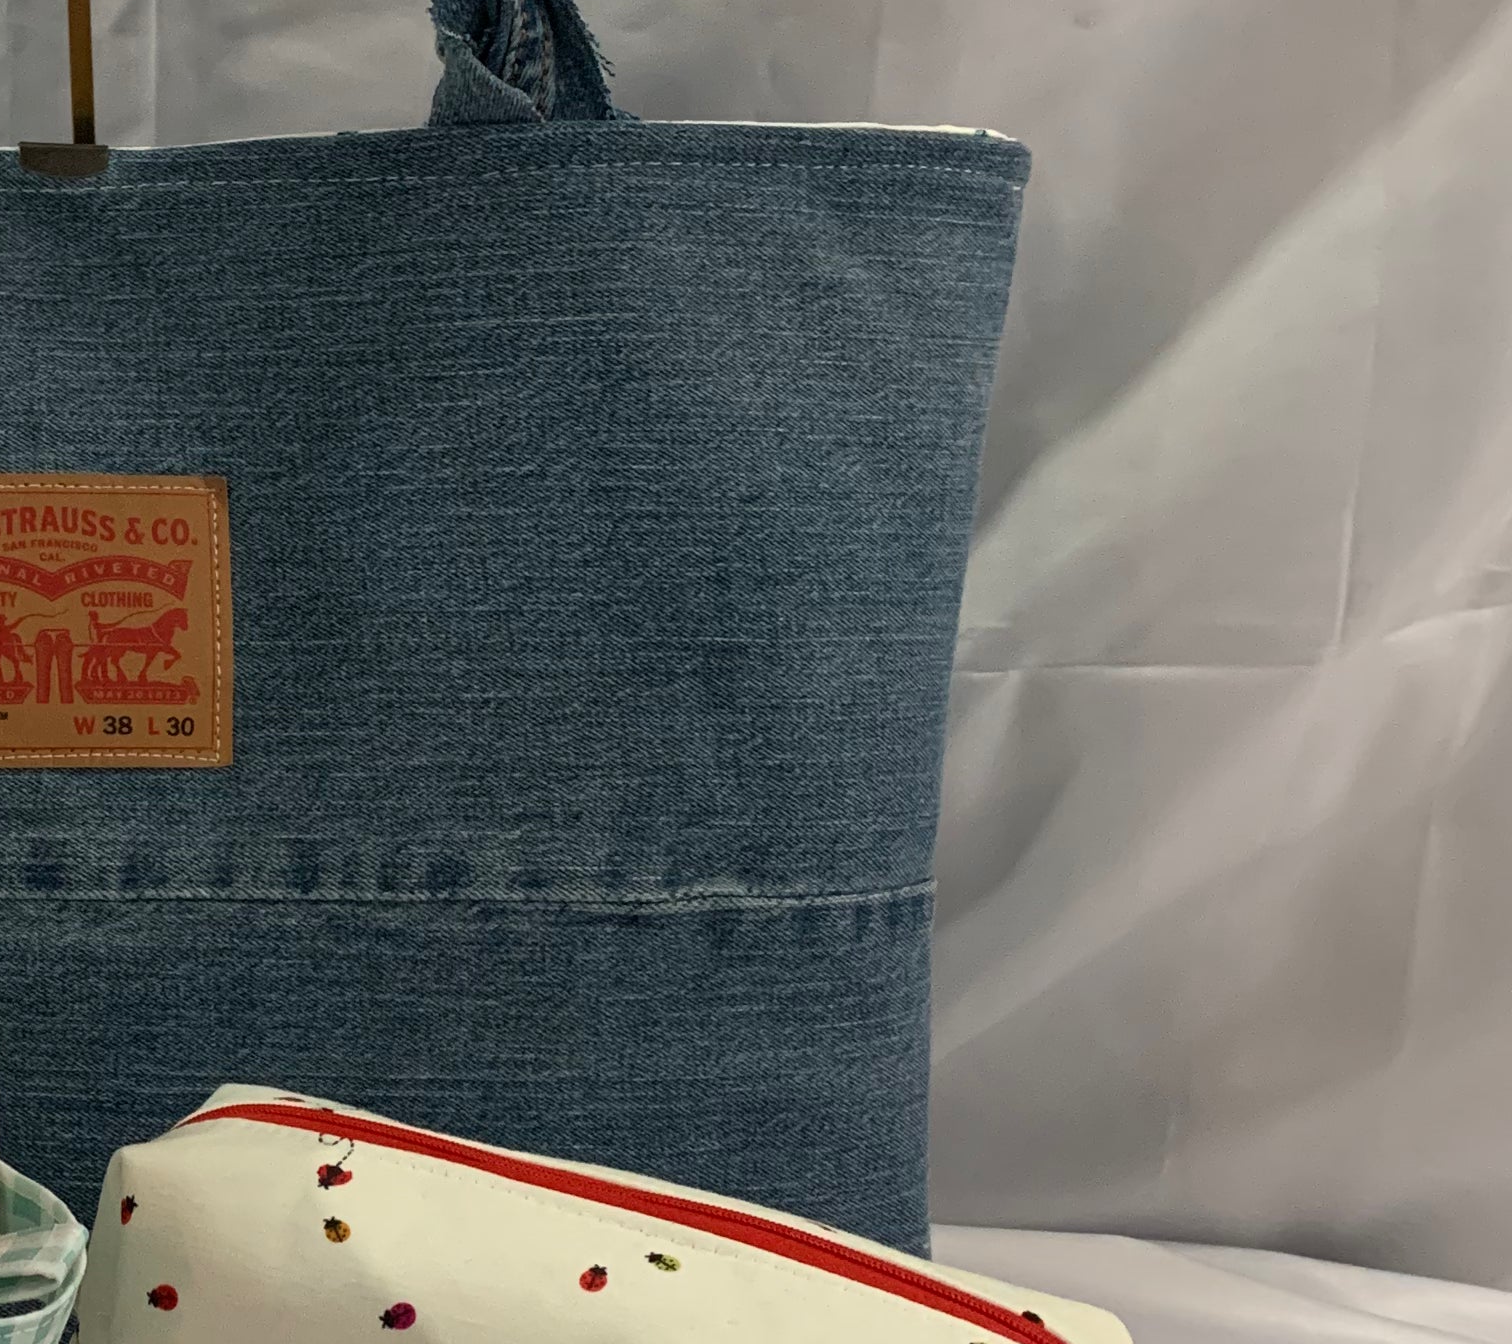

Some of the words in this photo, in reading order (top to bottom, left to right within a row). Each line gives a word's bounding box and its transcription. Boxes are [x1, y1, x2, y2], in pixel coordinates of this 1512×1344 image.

[124, 517, 145, 545] &
[151, 518, 198, 545] CO.
[2, 540, 26, 552] SAN
[31, 538, 98, 553] FRANCISCO
[39, 552, 66, 562] CAL.
[64, 562, 176, 587] RIVETED
[81, 591, 154, 608] CLOTHING
[73, 716, 96, 735] W
[103, 715, 133, 735] 38
[148, 716, 160, 736] L
[166, 716, 195, 736] 30
